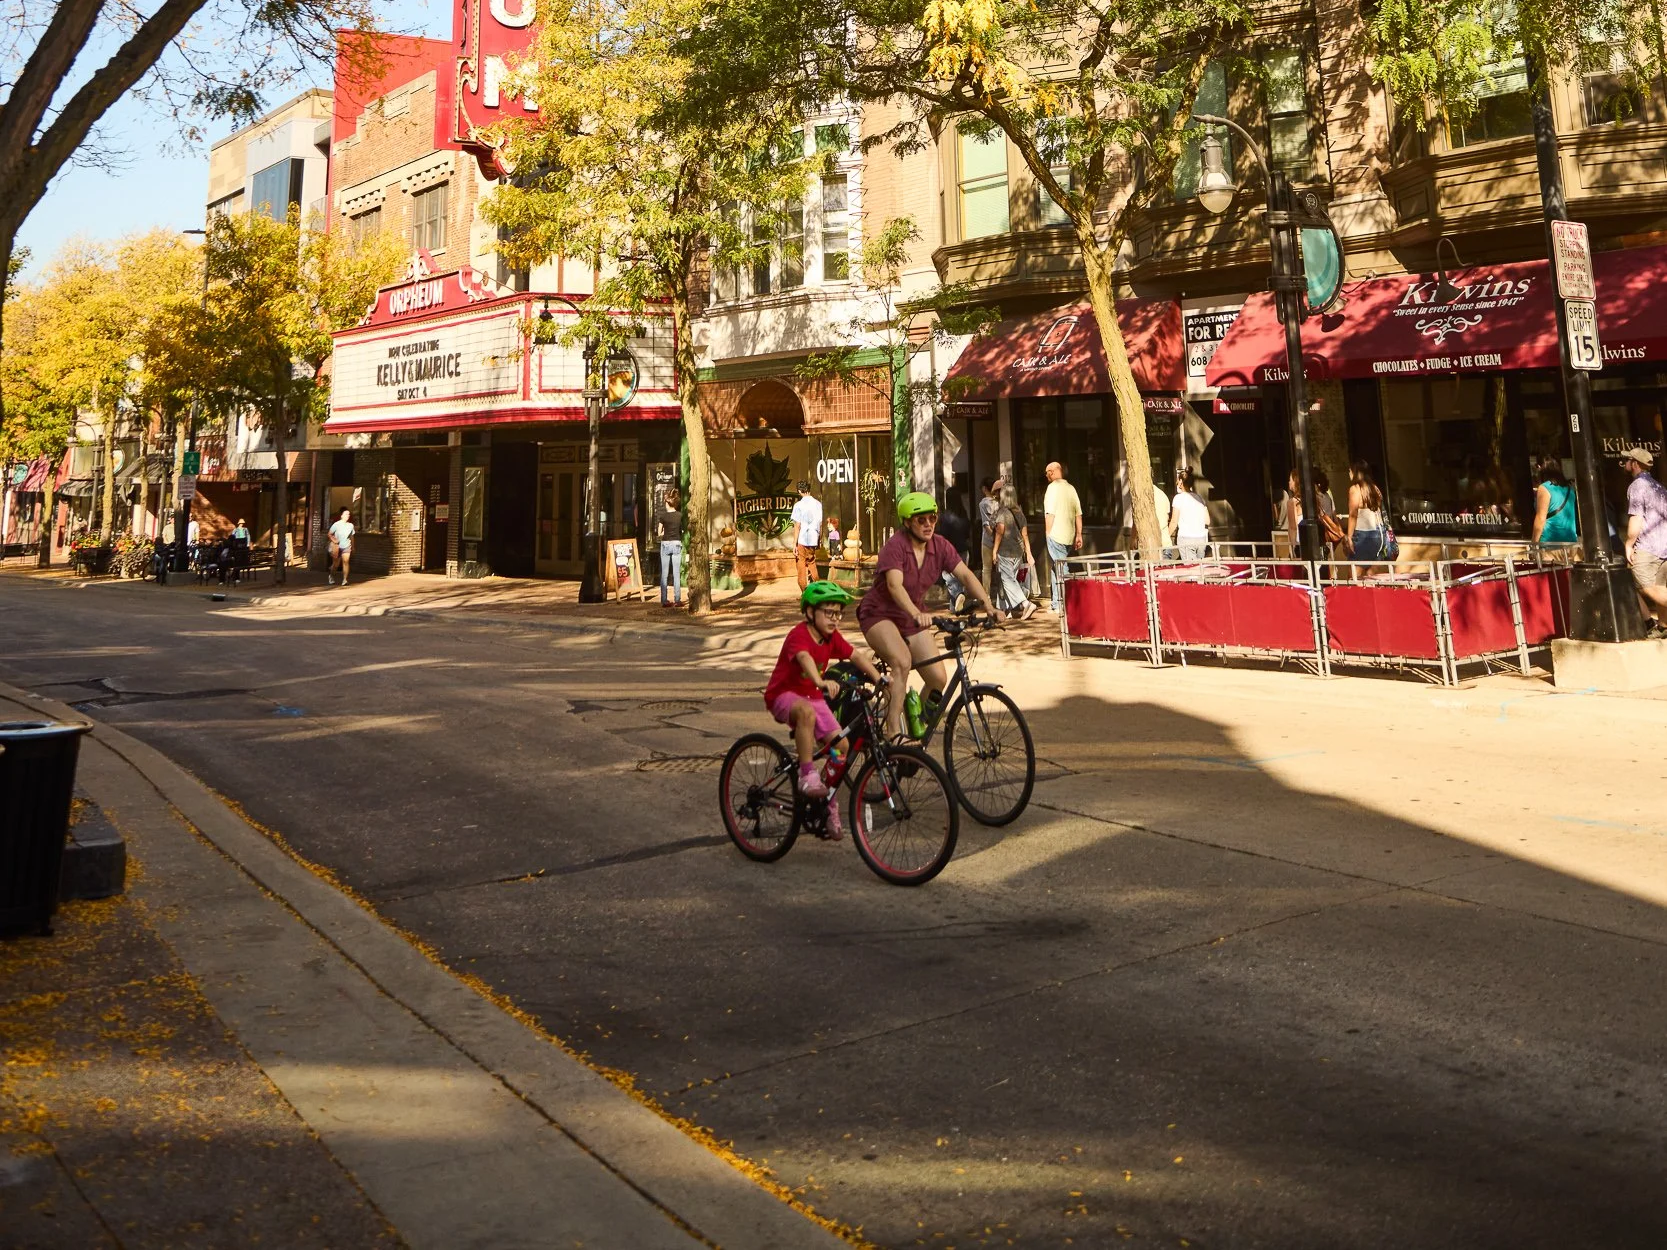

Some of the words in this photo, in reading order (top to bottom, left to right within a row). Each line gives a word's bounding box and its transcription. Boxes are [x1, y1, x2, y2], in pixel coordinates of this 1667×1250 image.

[1556, 226, 1565, 238] NO
[1560, 249, 1586, 260] STANDING
[1563, 262, 1586, 273] PARKING
[389, 279, 444, 315] ORPHEUM
[1398, 275, 1531, 307] Kiwins
[1419, 306, 1427, 315] in
[1428, 305, 1451, 314] every
[1475, 300, 1496, 310] since
[1568, 307, 1593, 320] SPEED
[1188, 325, 1212, 341] FOR
[1215, 323, 1233, 339] RE
[1572, 320, 1592, 332] LIMIT
[1574, 335, 1595, 363] 15
[1599, 343, 1646, 360] ilwins
[1012, 356, 1040, 368] CASK
[1038, 355, 1048, 366] &
[1048, 353, 1072, 365] ALE
[1190, 356, 1208, 367] 608
[1372, 359, 1419, 373] CHOCOLATES
[1426, 357, 1451, 370] FUDGE
[1459, 355, 1473, 368] ICE
[1474, 353, 1502, 367] CREAM
[1263, 367, 1308, 382] Kilws
[1147, 400, 1163, 409] CASK
[1163, 400, 1170, 409] &
[1170, 401, 1182, 410] ALE
[816, 458, 854, 483] OPEN
[735, 496, 773, 515] HIGHER
[1408, 512, 1453, 524] CHOCOLATES
[1461, 513, 1475, 525] ICE
[1475, 513, 1502, 526] CREAM
